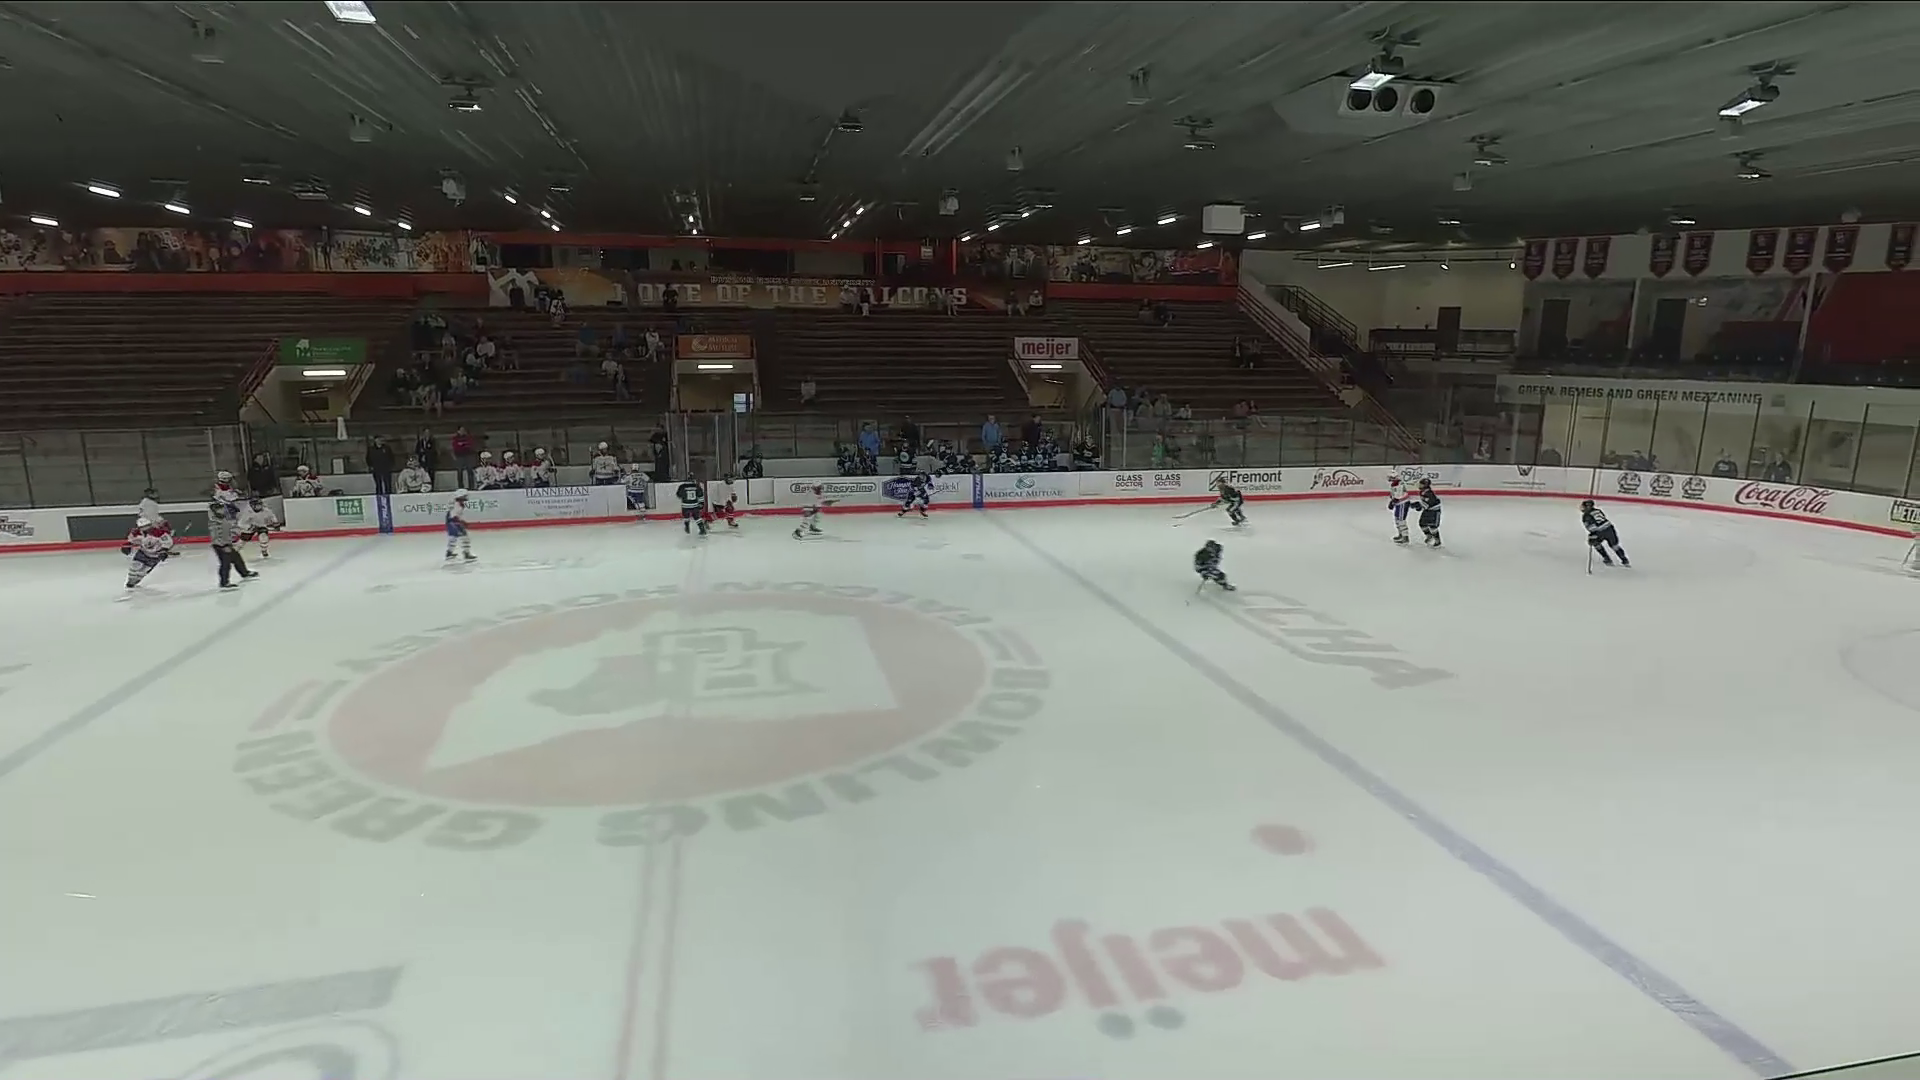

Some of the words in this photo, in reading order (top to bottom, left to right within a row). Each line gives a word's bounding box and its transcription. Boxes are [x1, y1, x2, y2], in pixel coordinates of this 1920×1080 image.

[716, 284, 752, 304] OF
[766, 285, 828, 305] THE
[1021, 339, 1072, 357] meijer
[1559, 386, 1604, 400] REMEIS
[1607, 387, 1633, 401] AND
[1636, 388, 1679, 402] GREEN
[1681, 390, 1762, 405] MEZZANINE
[1115, 474, 1143, 482] GLASS
[1153, 480, 1181, 488] DOCTOR
[1154, 473, 1181, 481] GLASS
[1229, 470, 1282, 484] Fremont
[1321, 473, 1341, 488] Red
[1340, 471, 1364, 487] Robin
[525, 486, 590, 498] HANNEMAN
[826, 482, 874, 494] Recycling
[984, 489, 1023, 498] MEDICAL
[1025, 488, 1063, 498] MUTUAL
[1734, 481, 1834, 514] Coca-Cola
[403, 504, 426, 514] CAFE
[596, 666, 1052, 848] BOWLING
[231, 729, 546, 851] GREEN
[908, 905, 1390, 1041] meijer
